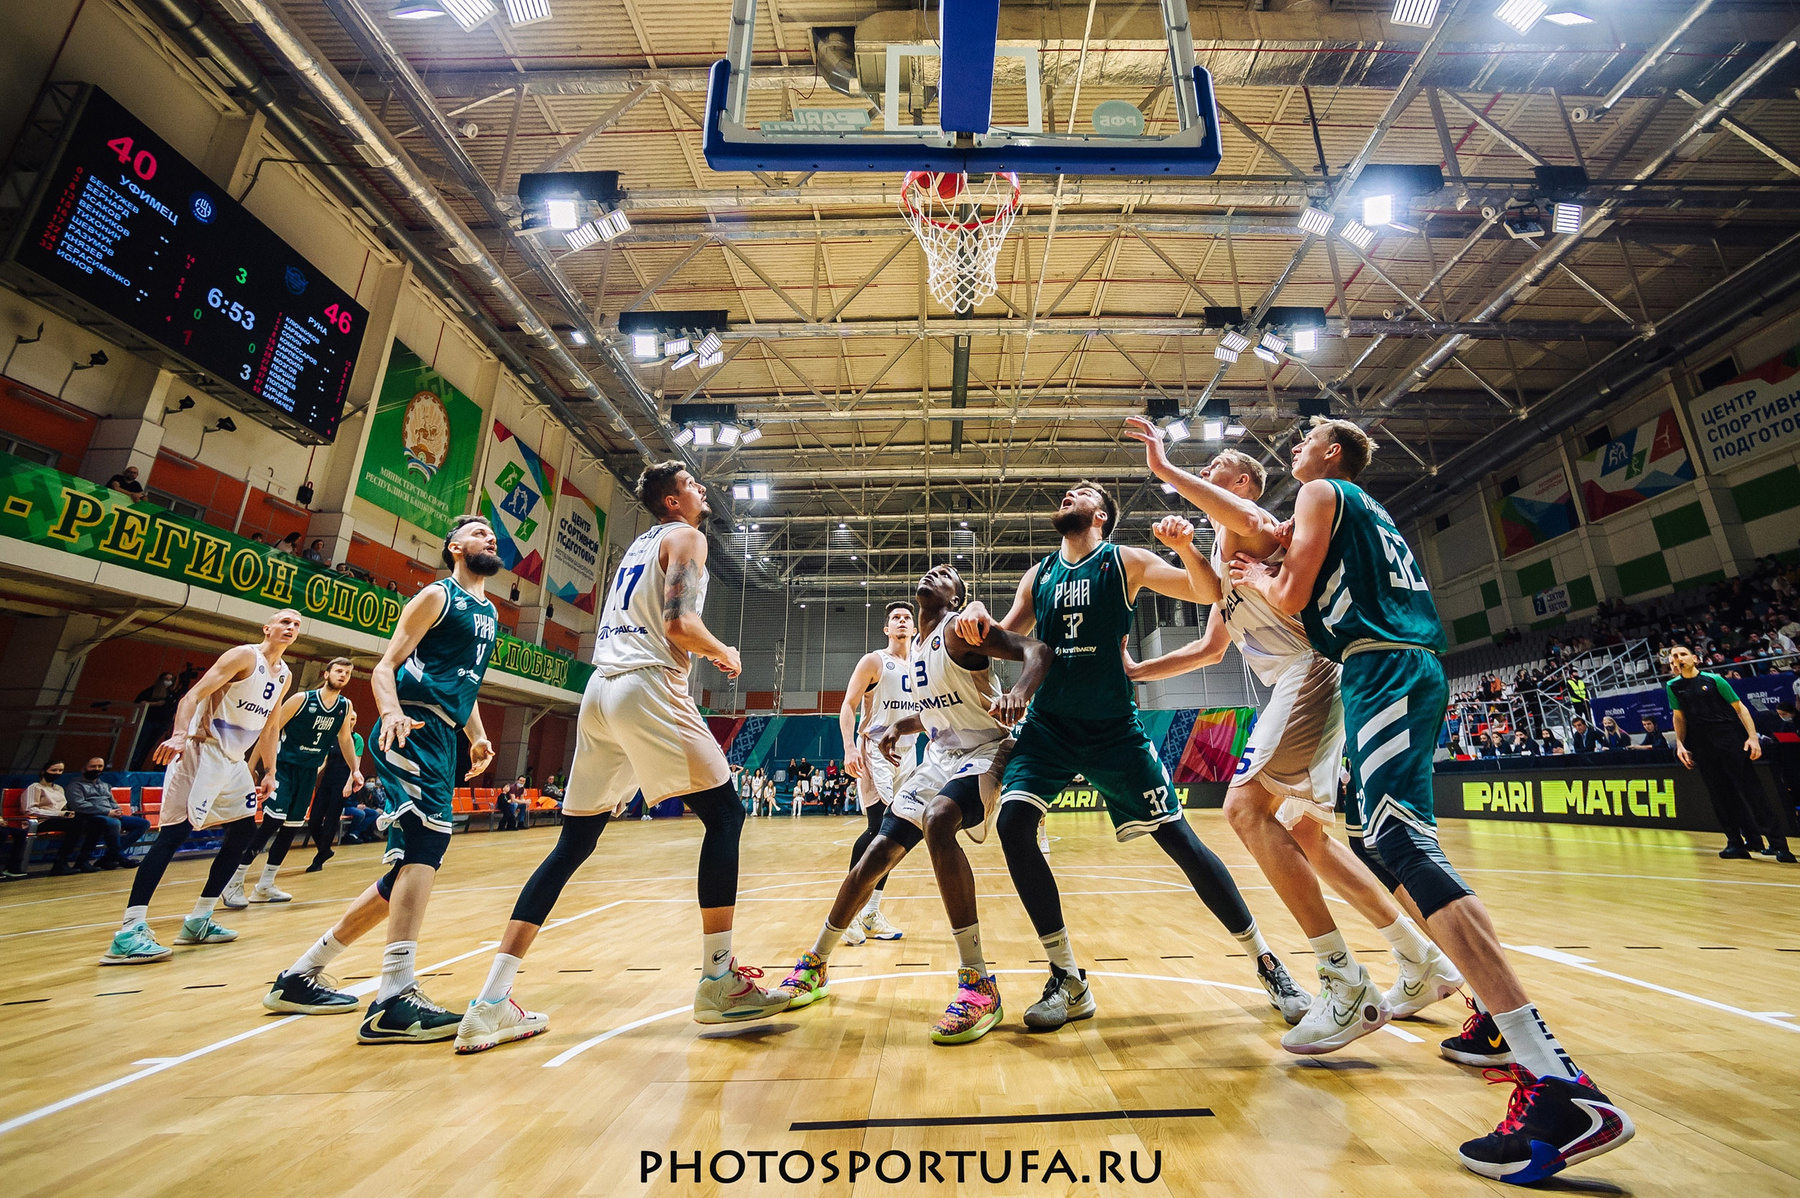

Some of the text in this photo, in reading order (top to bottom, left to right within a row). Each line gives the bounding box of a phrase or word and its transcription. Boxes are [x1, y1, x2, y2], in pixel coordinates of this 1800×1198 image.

[107, 137, 157, 180] 40
[76, 166, 140, 214] 0 БЕСТУЖЕВ
[86, 183, 130, 218] БЕРНАРД
[119, 174, 178, 226] УФИМЕЦ
[78, 199, 130, 237] ВЕННИКОВ
[82, 191, 122, 222] ИСАКОВ
[52, 214, 115, 257] 17 РАЗУМОВ
[71, 215, 114, 246] ШЕВЧУК
[75, 206, 122, 242] ТИХОНИН
[46, 221, 104, 260] 22 КНЯЗЕВ
[43, 230, 132, 287] 24 ГЕРАСИМЕНКО
[56, 248, 94, 275] ИОНОВ
[236, 268, 248, 284] 3
[193, 308, 202, 320] 0
[208, 288, 256, 330] 6:53
[324, 304, 352, 334] 46
[308, 316, 328, 336] РУНА
[279, 336, 318, 366] КОМИССАРОВ
[240, 364, 252, 381] 3
[1701, 390, 1757, 426] ЦЕНТР
[1707, 390, 1800, 443] СПОРТИВН
[365, 472, 410, 502] РЕСПУБЛИКИ
[380, 466, 428, 500] МИНИСТЕРСТВО
[572, 511, 592, 533] ЦЕНТР
[48, 487, 298, 604] РЕГИОН
[305, 574, 404, 632] СПОР
[1376, 524, 1430, 592] 52
[1054, 578, 1091, 609] РУНА
[473, 613, 496, 642] РУНА
[505, 642, 569, 688] ПОБЕД!
[914, 660, 928, 688] 3
[262, 682, 276, 700] 8
[882, 700, 920, 712] УФИМЕ
[312, 732, 323, 746] 3
[245, 792, 256, 808] 8
[1048, 790, 1098, 809] PARI
[1462, 779, 1677, 818] PARI MATCH
